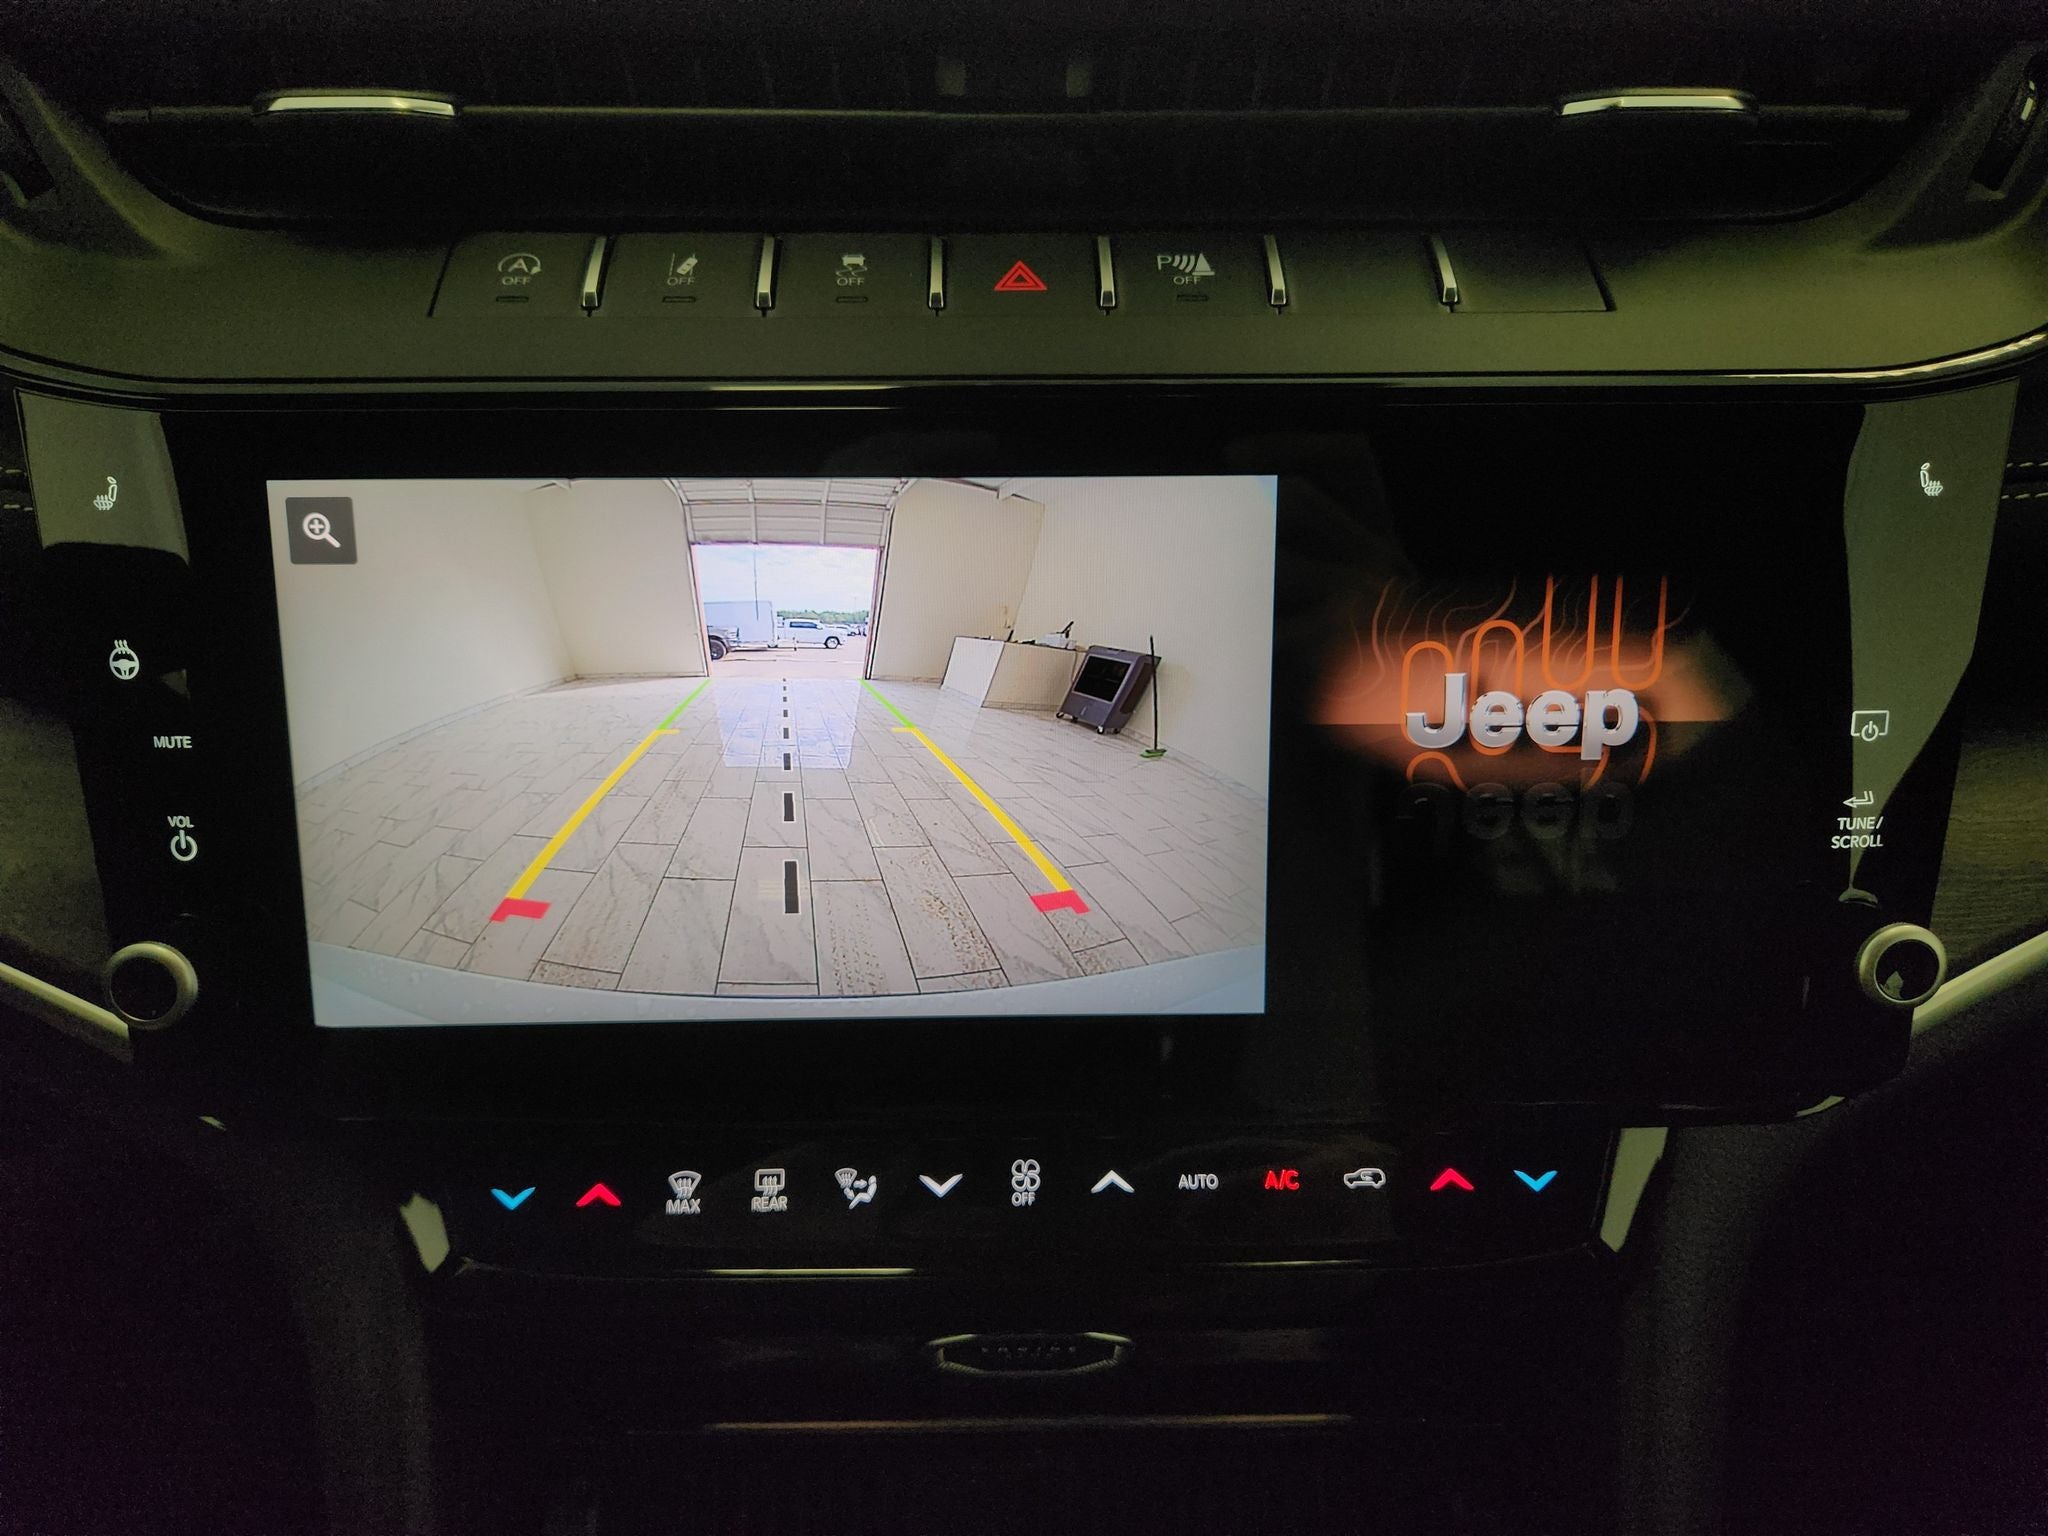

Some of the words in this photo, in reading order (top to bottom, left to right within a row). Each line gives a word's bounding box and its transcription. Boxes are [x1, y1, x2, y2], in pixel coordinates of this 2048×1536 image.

[508, 259, 530, 272] A
[1157, 256, 1172, 270] P
[502, 276, 531, 286] OFF
[666, 276, 696, 286] OFF
[836, 276, 865, 286] OFF
[1173, 275, 1200, 285] OFF
[1406, 673, 1640, 760] Jeep
[153, 736, 192, 748] MUTE
[167, 816, 194, 828] VOL
[1837, 816, 1883, 830] TUNE/
[1831, 835, 1883, 849] SCROLL
[1178, 1174, 1219, 1190] AUTO
[1265, 1170, 1300, 1190] A/C
[751, 1196, 788, 1212] REAR
[1011, 1191, 1036, 1207] OFF
[666, 1198, 701, 1215] MAX
